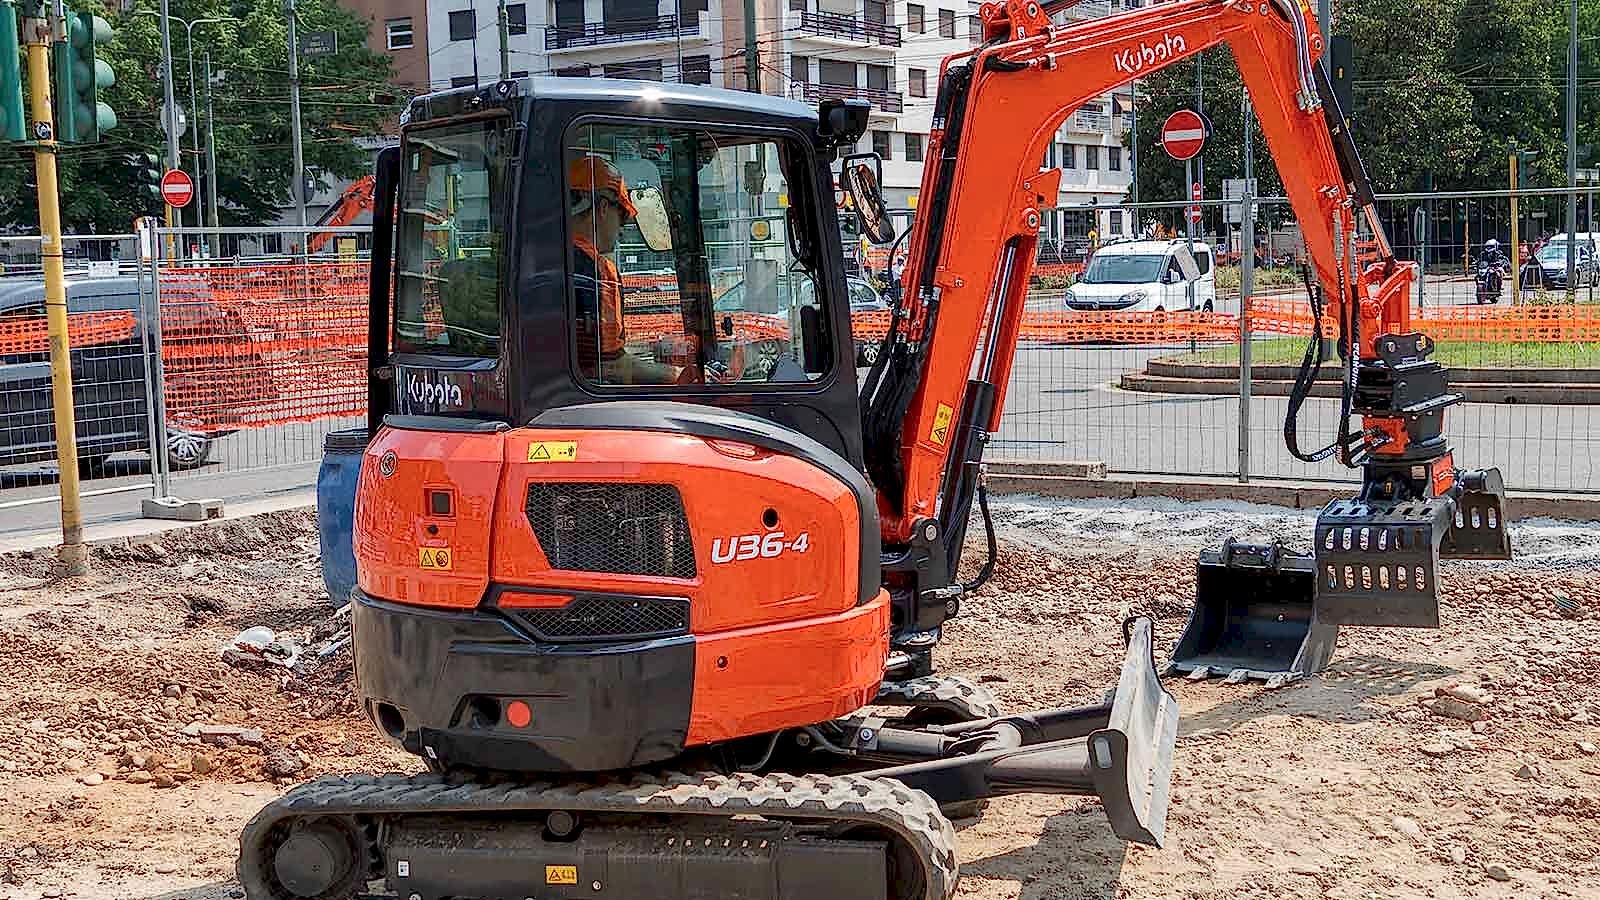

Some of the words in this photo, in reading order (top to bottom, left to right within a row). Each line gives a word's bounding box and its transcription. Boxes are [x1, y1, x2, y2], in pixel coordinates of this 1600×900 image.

[1114, 32, 1187, 73] Kubota
[407, 373, 463, 406] Kubota
[711, 531, 809, 564] U36-4
